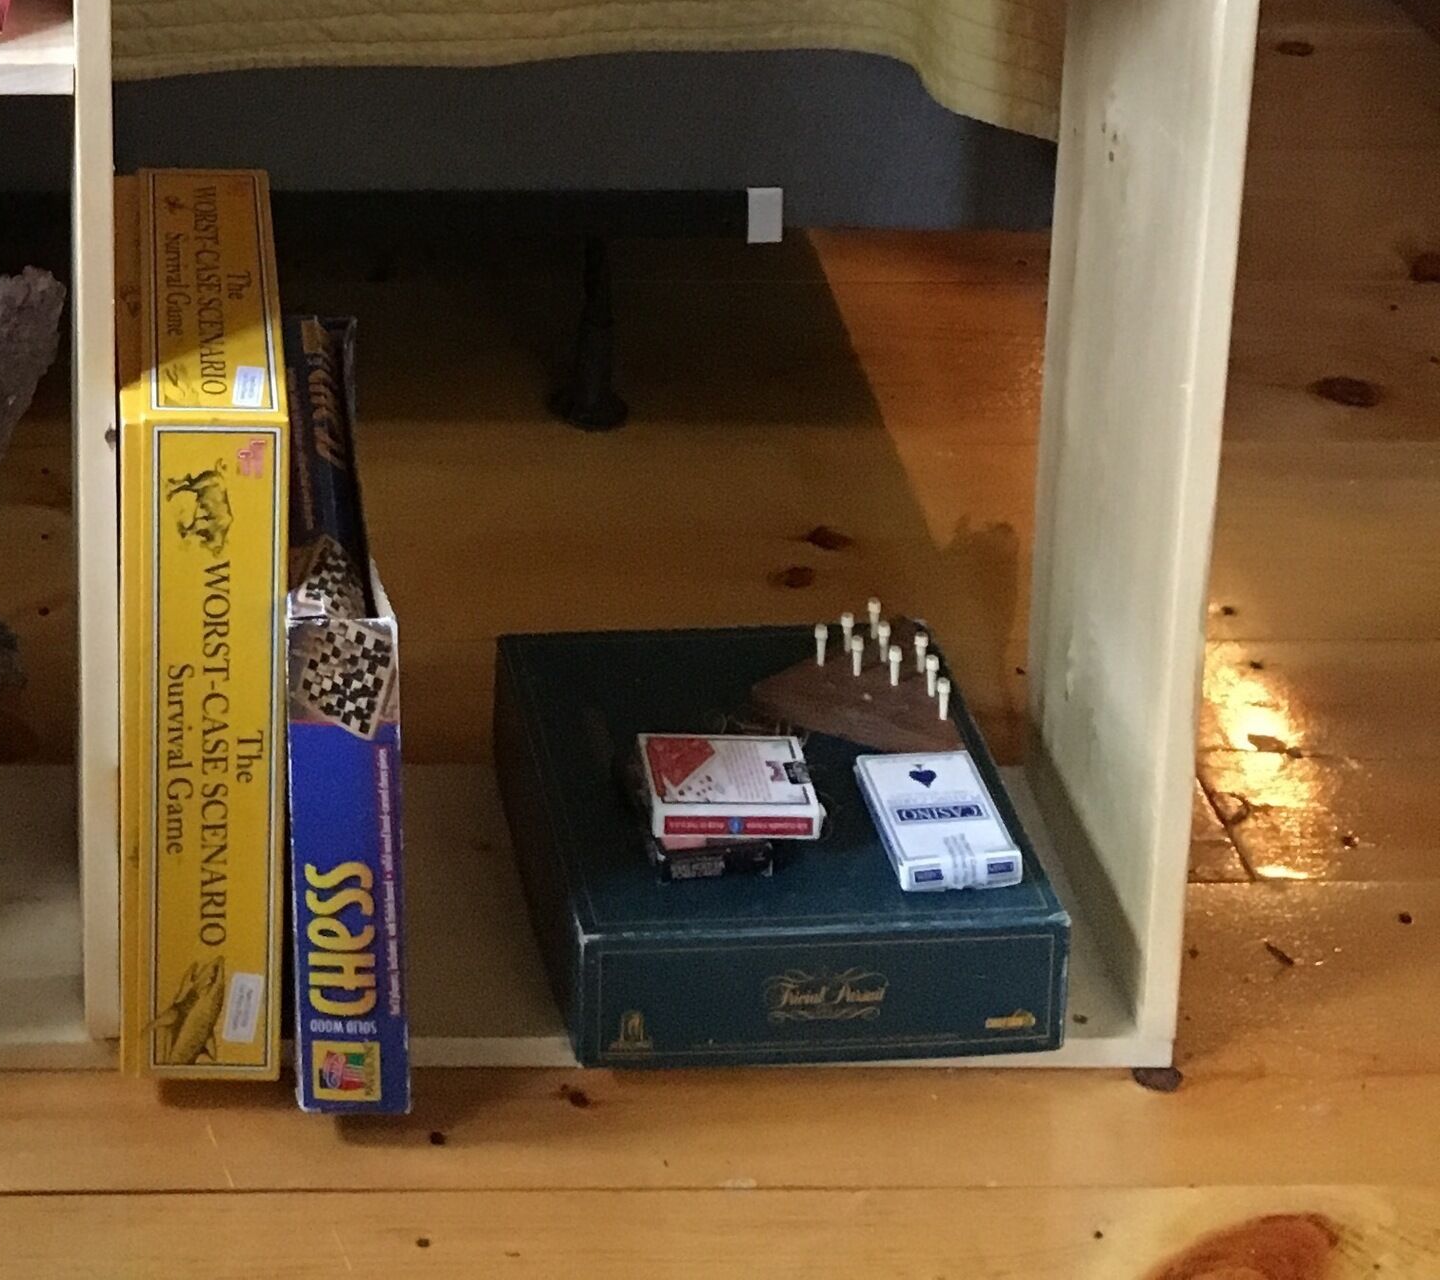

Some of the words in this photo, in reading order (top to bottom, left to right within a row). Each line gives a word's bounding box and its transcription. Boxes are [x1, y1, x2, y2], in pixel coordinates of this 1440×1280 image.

[164, 233, 191, 290] Survival
[192, 184, 222, 291] WORST-CASE
[165, 291, 192, 337] Game
[226, 270, 253, 301] The
[197, 293, 228, 396] SCENARIO
[201, 561, 231, 776] WORST-CASE
[166, 662, 195, 771] Survival
[236, 729, 265, 784] The
[165, 775, 195, 855] Game
[899, 804, 980, 822] CASINO
[198, 782, 230, 948] SCENARIO
[309, 1018, 344, 1033] WOOD
[345, 1019, 378, 1035] SOLID
